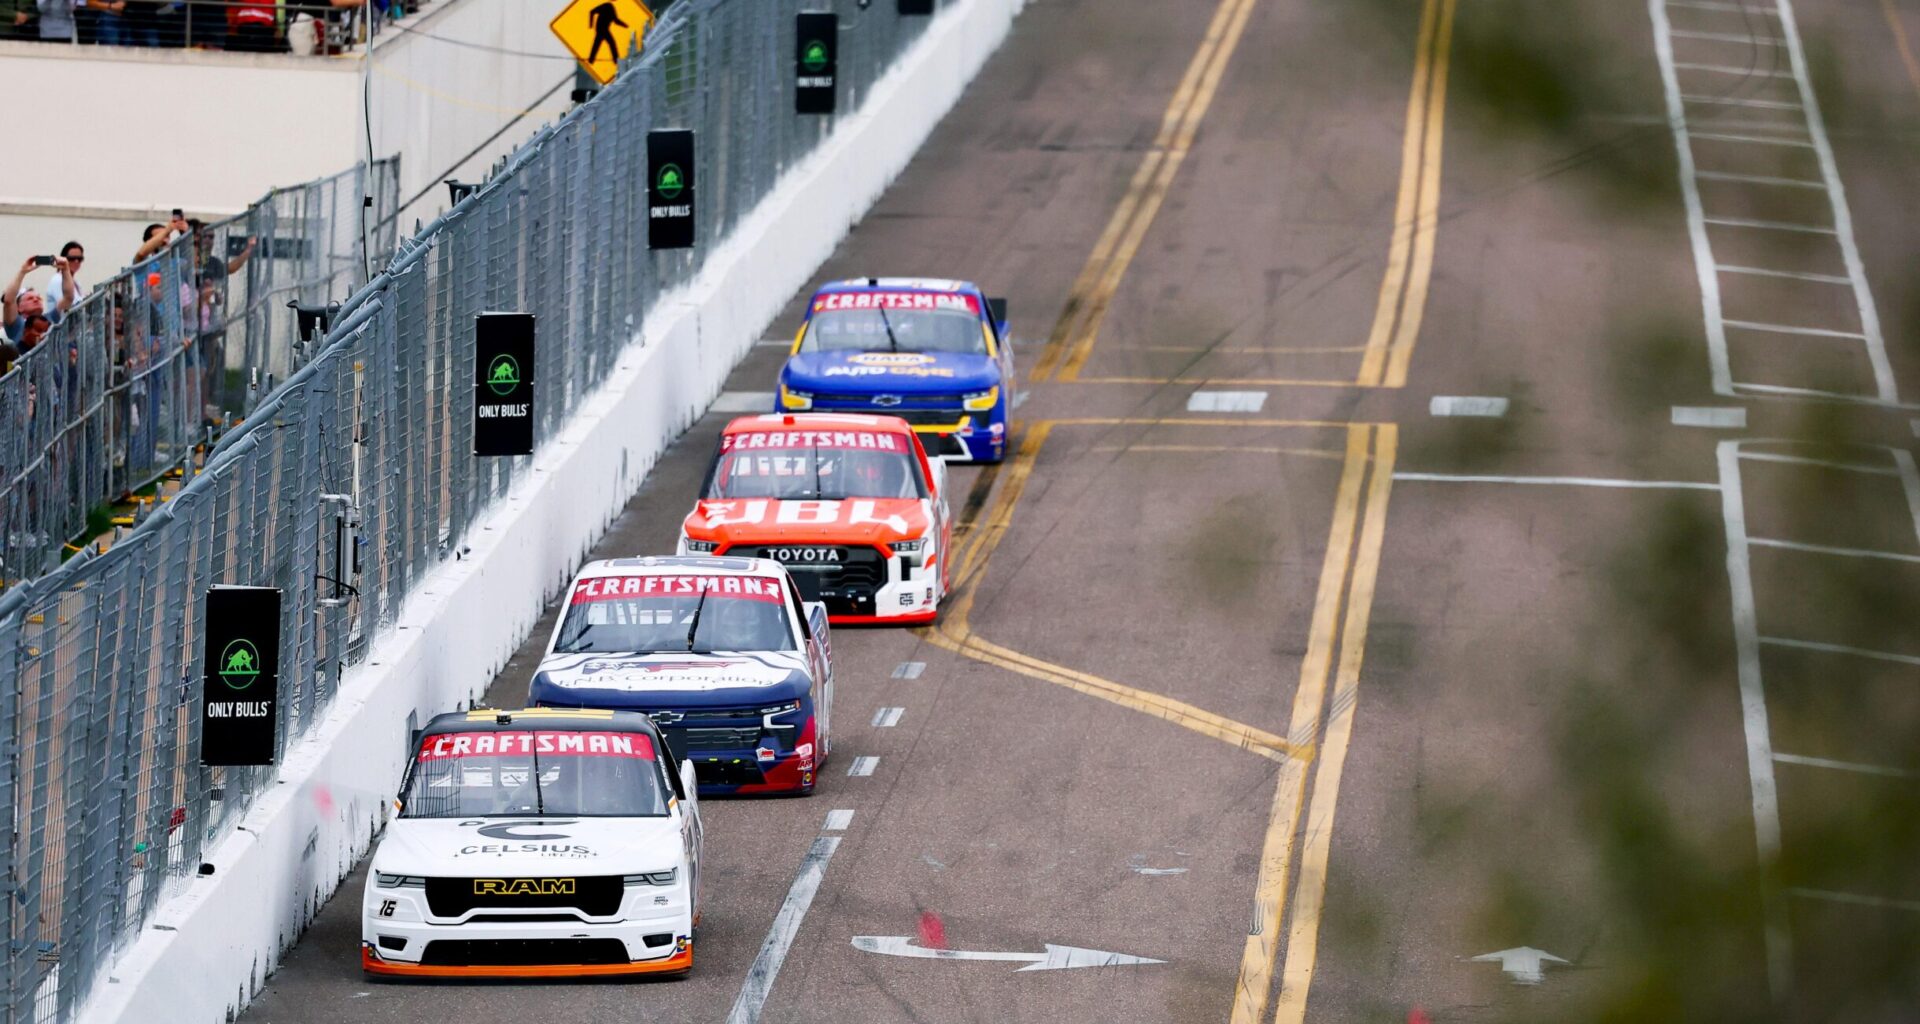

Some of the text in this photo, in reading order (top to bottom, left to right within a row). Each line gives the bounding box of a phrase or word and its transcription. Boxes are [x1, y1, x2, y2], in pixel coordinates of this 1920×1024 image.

[825, 293, 968, 310] CRAFTSMAN
[824, 366, 886, 377] AUTO
[479, 405, 500, 418] ONLY
[734, 432, 895, 449] CRAFTSMAN
[706, 500, 908, 535] JBL
[767, 549, 839, 561] TOYOTA
[586, 577, 763, 596] CRAFTSMAN
[208, 702, 234, 718] ONLY
[433, 735, 634, 757] CRAFTSMAN
[460, 844, 590, 855] CELSIUS
[474, 879, 575, 894] RAM
[379, 899, 397, 917] 16
